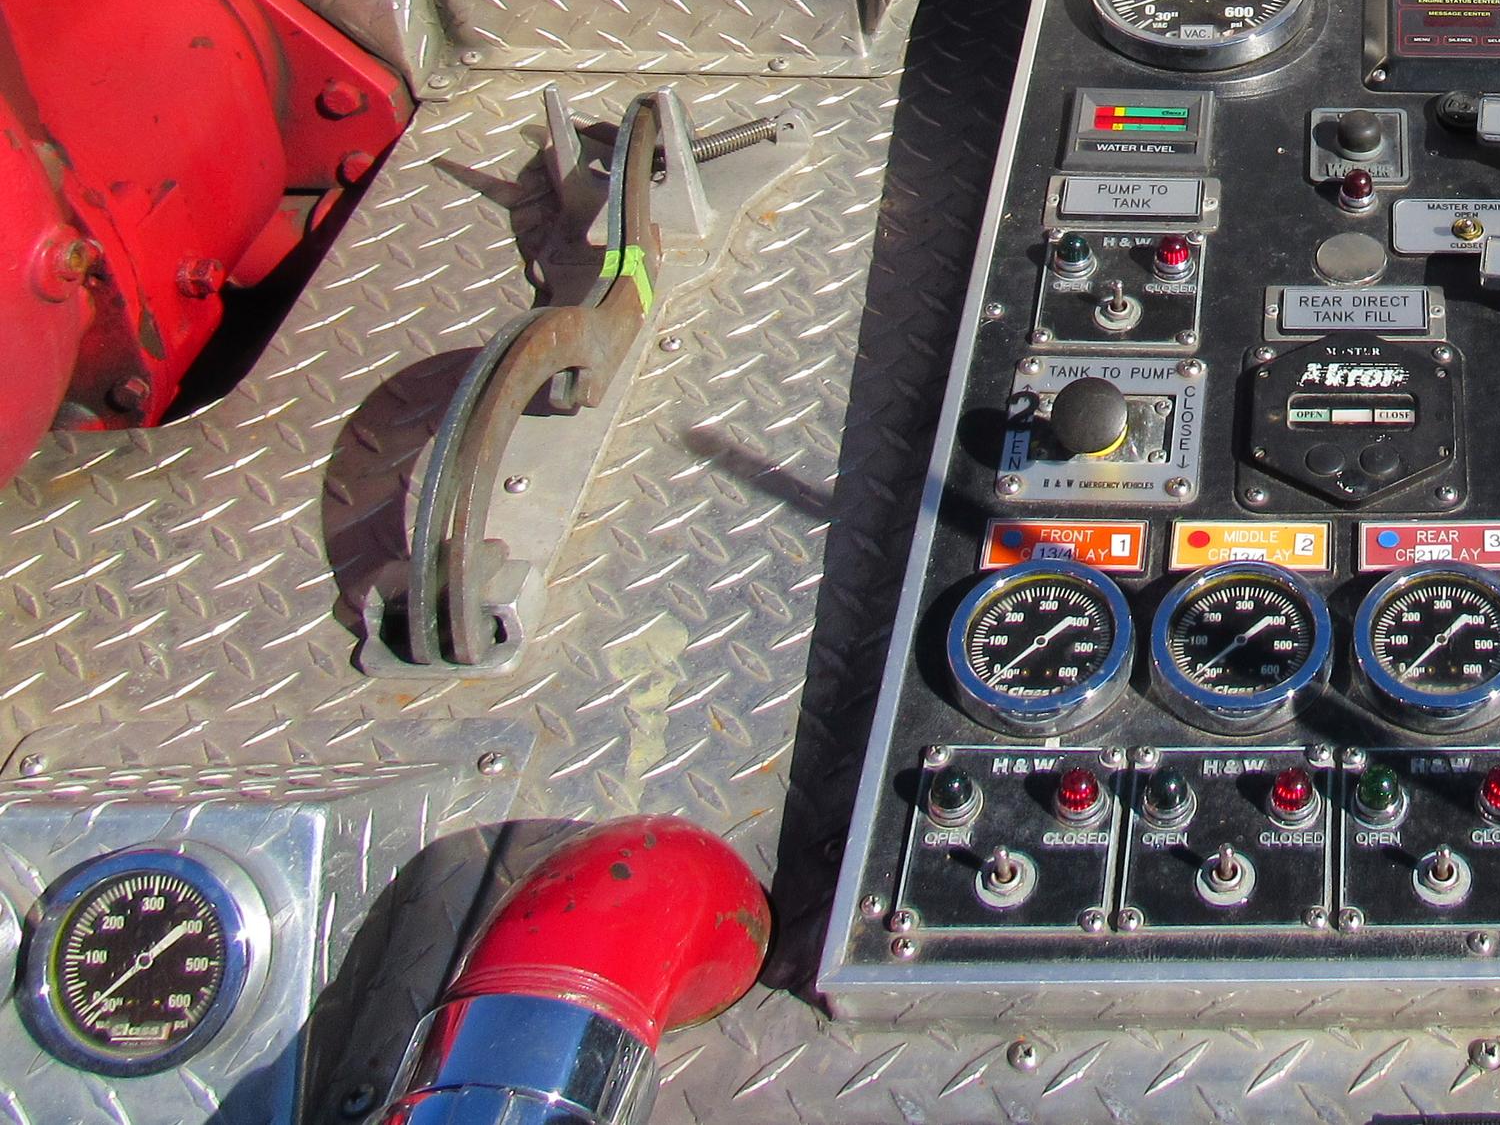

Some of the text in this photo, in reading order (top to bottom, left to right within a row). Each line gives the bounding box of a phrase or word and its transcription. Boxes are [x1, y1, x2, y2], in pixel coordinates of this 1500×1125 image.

[1224, 6, 1254, 18] 600
[1183, 28, 1211, 39] VAC.
[1096, 143, 1176, 153] WATER LEVEL
[1097, 184, 1168, 196] PUMP TO
[1113, 198, 1151, 209] TANK
[1427, 203, 1471, 211] MASTER
[1103, 236, 1116, 248] H
[1136, 236, 1152, 246] W
[1053, 281, 1093, 292] OPEN
[1145, 282, 1198, 294] CLOSED
[1299, 295, 1410, 307] REAR DIRECT
[1313, 311, 1397, 323] TANK FILL
[1049, 365, 1177, 380] TANK TO PUMP
[1296, 411, 1324, 419] OPEN
[1079, 481, 1154, 490] EMERGENCY VEHICLES
[1040, 529, 1094, 542] FRONT
[1224, 531, 1280, 543] MIDDLE
[1416, 530, 1459, 543] REAR
[1119, 539, 1126, 553] 1
[1301, 538, 1313, 552] 2
[1039, 601, 1059, 611] 300
[1235, 600, 1255, 610] 300
[1433, 600, 1452, 610] 300
[1004, 612, 1024, 623] 200
[1203, 612, 1222, 622] 200
[1402, 612, 1421, 622] 200
[989, 635, 1008, 646] 100
[1273, 641, 1293, 650] 500
[1390, 635, 1409, 645] 100
[1474, 640, 1493, 650] 500
[1074, 643, 1093, 653] 500
[1058, 667, 1078, 677] 600
[1463, 664, 1482, 674] 600
[992, 759, 1009, 773] H
[1033, 758, 1055, 773] W
[923, 832, 973, 846] OPEN
[1042, 832, 1110, 846] CLOSED
[1142, 832, 1188, 846] OPEN
[1259, 832, 1325, 846] CLOSED
[1355, 832, 1402, 846] OPEN
[142, 897, 165, 911] 300
[102, 915, 124, 930] 200
[185, 957, 209, 972] 500
[168, 994, 191, 1009] 600
